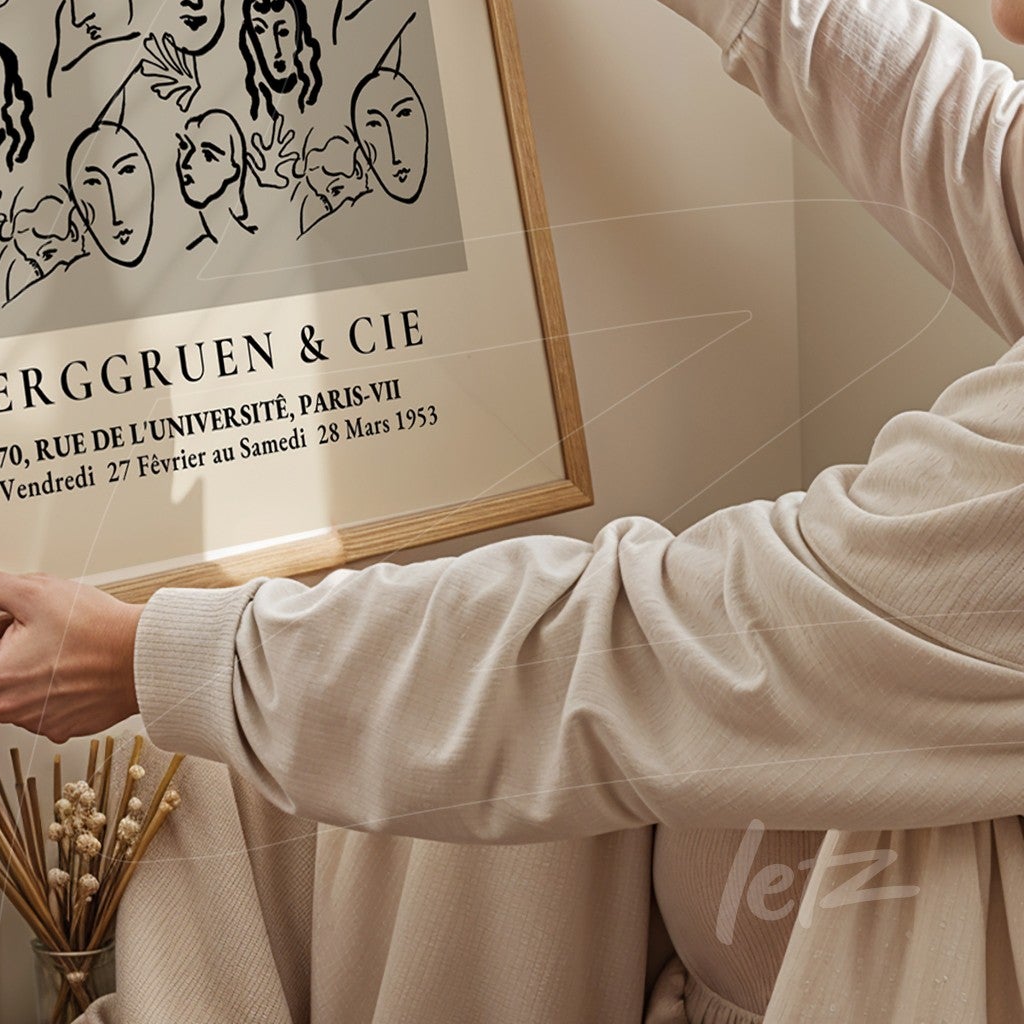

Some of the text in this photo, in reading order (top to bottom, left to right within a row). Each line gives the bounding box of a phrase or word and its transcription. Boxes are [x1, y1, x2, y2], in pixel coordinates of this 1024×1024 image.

[299, 323, 330, 364] &
[349, 309, 425, 356] CIE
[34, 432, 87, 462] RUE
[90, 426, 126, 452] DE
[298, 378, 402, 416] PARIS-VII
[106, 459, 131, 483] 27
[212, 446, 235, 464] au
[239, 427, 307, 459] Samedi
[317, 422, 340, 445] 28
[344, 416, 391, 440] Mars
[395, 405, 439, 431] 1953
